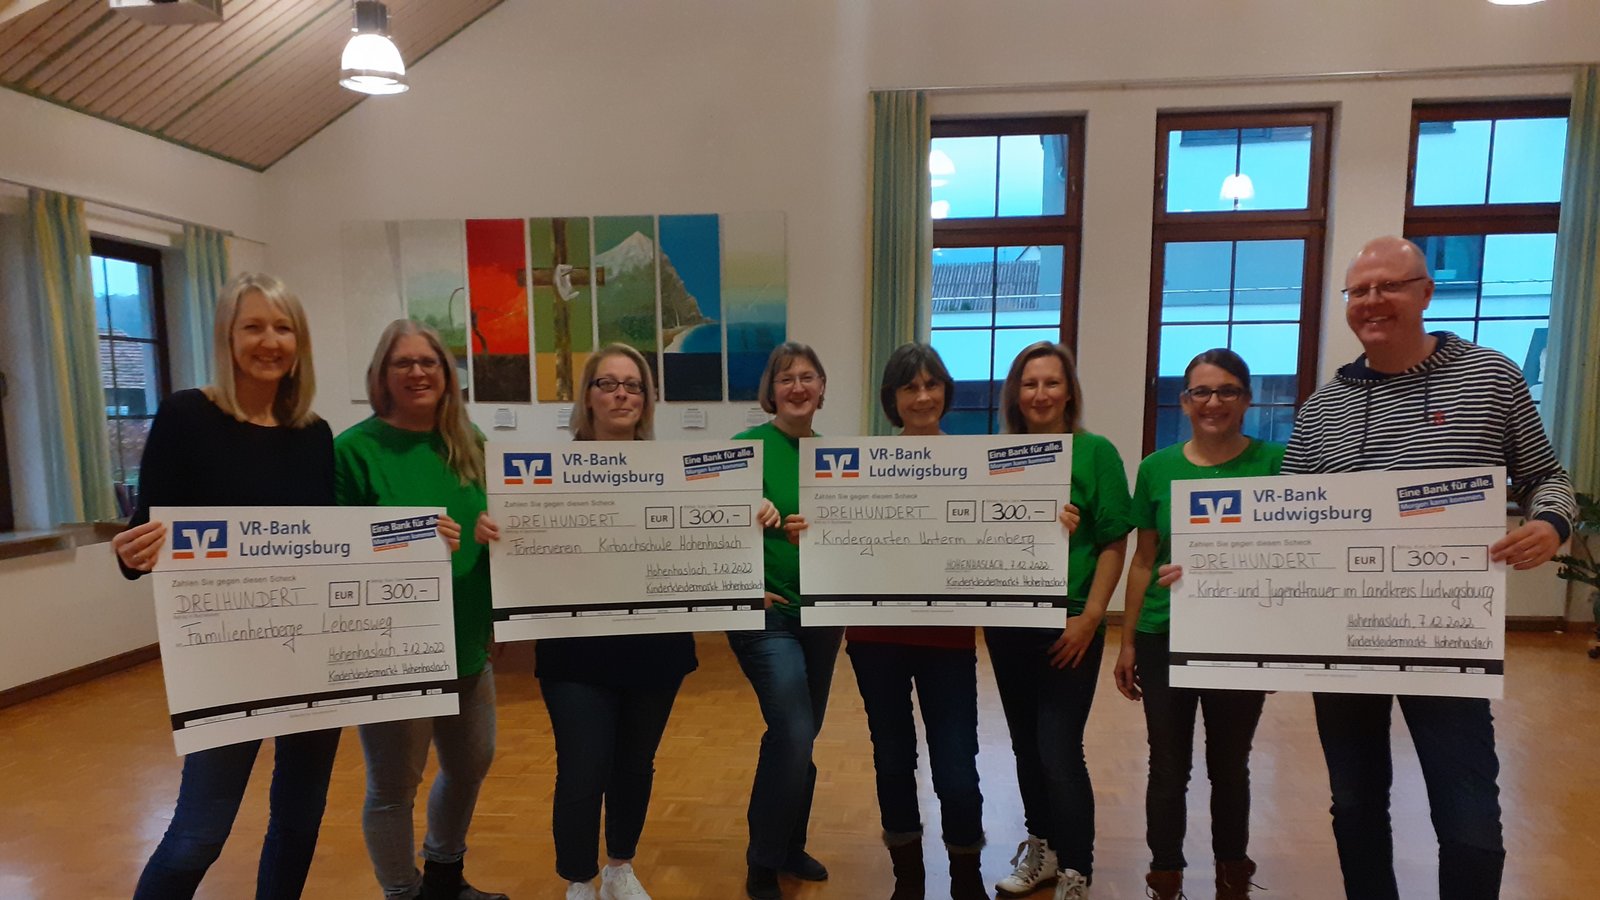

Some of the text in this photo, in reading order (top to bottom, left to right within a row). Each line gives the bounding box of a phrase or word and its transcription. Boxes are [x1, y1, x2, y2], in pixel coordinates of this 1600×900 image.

[562, 452, 627, 466] VR-Bank
[685, 457, 701, 465] Eine
[703, 453, 722, 462] Bank
[724, 451, 736, 459] für
[869, 447, 931, 460] VR-Bank
[990, 451, 1006, 459] Eine
[1008, 447, 1028, 456] Bank
[1030, 445, 1043, 453] für
[563, 470, 664, 486] Ludwigsburg
[869, 464, 968, 480] Ludwigsburg
[1253, 487, 1327, 502] VR-Bank
[1399, 489, 1420, 498] Eine
[1423, 483, 1449, 494] Bank
[1451, 481, 1467, 490] für
[508, 512, 619, 528] DREIHUNDERT
[651, 515, 668, 523] EUR
[816, 505, 930, 519] DREIHUNDERT
[952, 508, 969, 516] EUR
[1253, 505, 1372, 524] Ludwigsburg
[239, 519, 311, 535] VR-Bank
[372, 525, 390, 534] Eine
[391, 521, 411, 531] Bank
[412, 519, 424, 527] für
[240, 540, 351, 558] Ludwigsburg
[822, 529, 910, 556] Kindergarten
[1190, 552, 1321, 569] DREIHUNDERT
[1354, 556, 1376, 565] EUR
[175, 587, 306, 613] DREIHUNDERT
[334, 591, 354, 600] EUR
[1344, 586, 1357, 598] im
[1420, 578, 1495, 617] Ludwigsburg
[180, 612, 392, 653] Familienherberge Lebensweg
